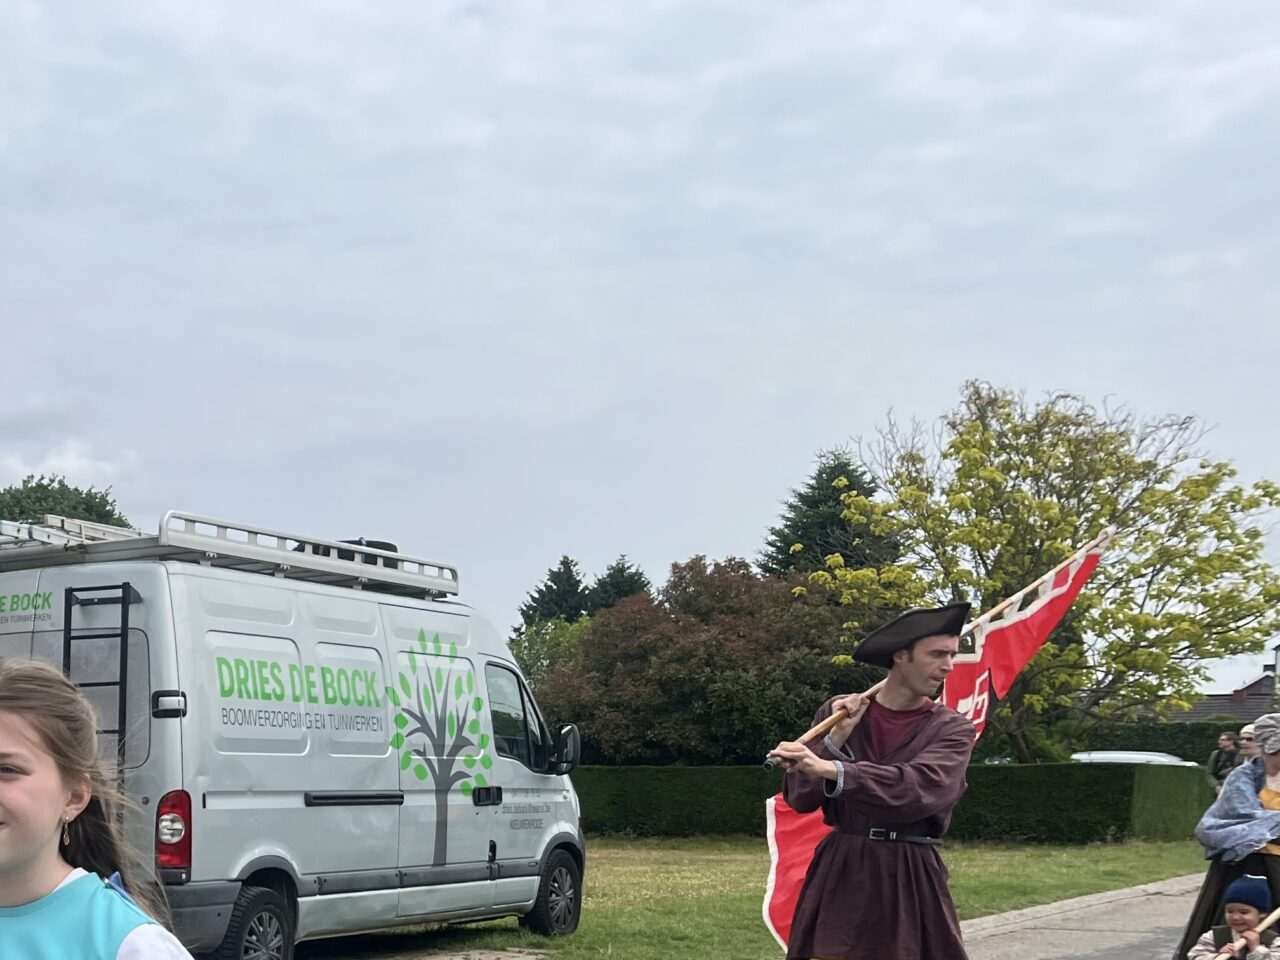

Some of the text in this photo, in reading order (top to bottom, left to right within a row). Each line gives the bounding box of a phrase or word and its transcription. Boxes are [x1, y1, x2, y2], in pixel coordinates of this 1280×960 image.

[9, 592, 53, 611] BOCK
[216, 656, 380, 707] DRIES DE BOCK
[221, 707, 384, 732] BOOMVERZORGING EN TUINWERKEN
